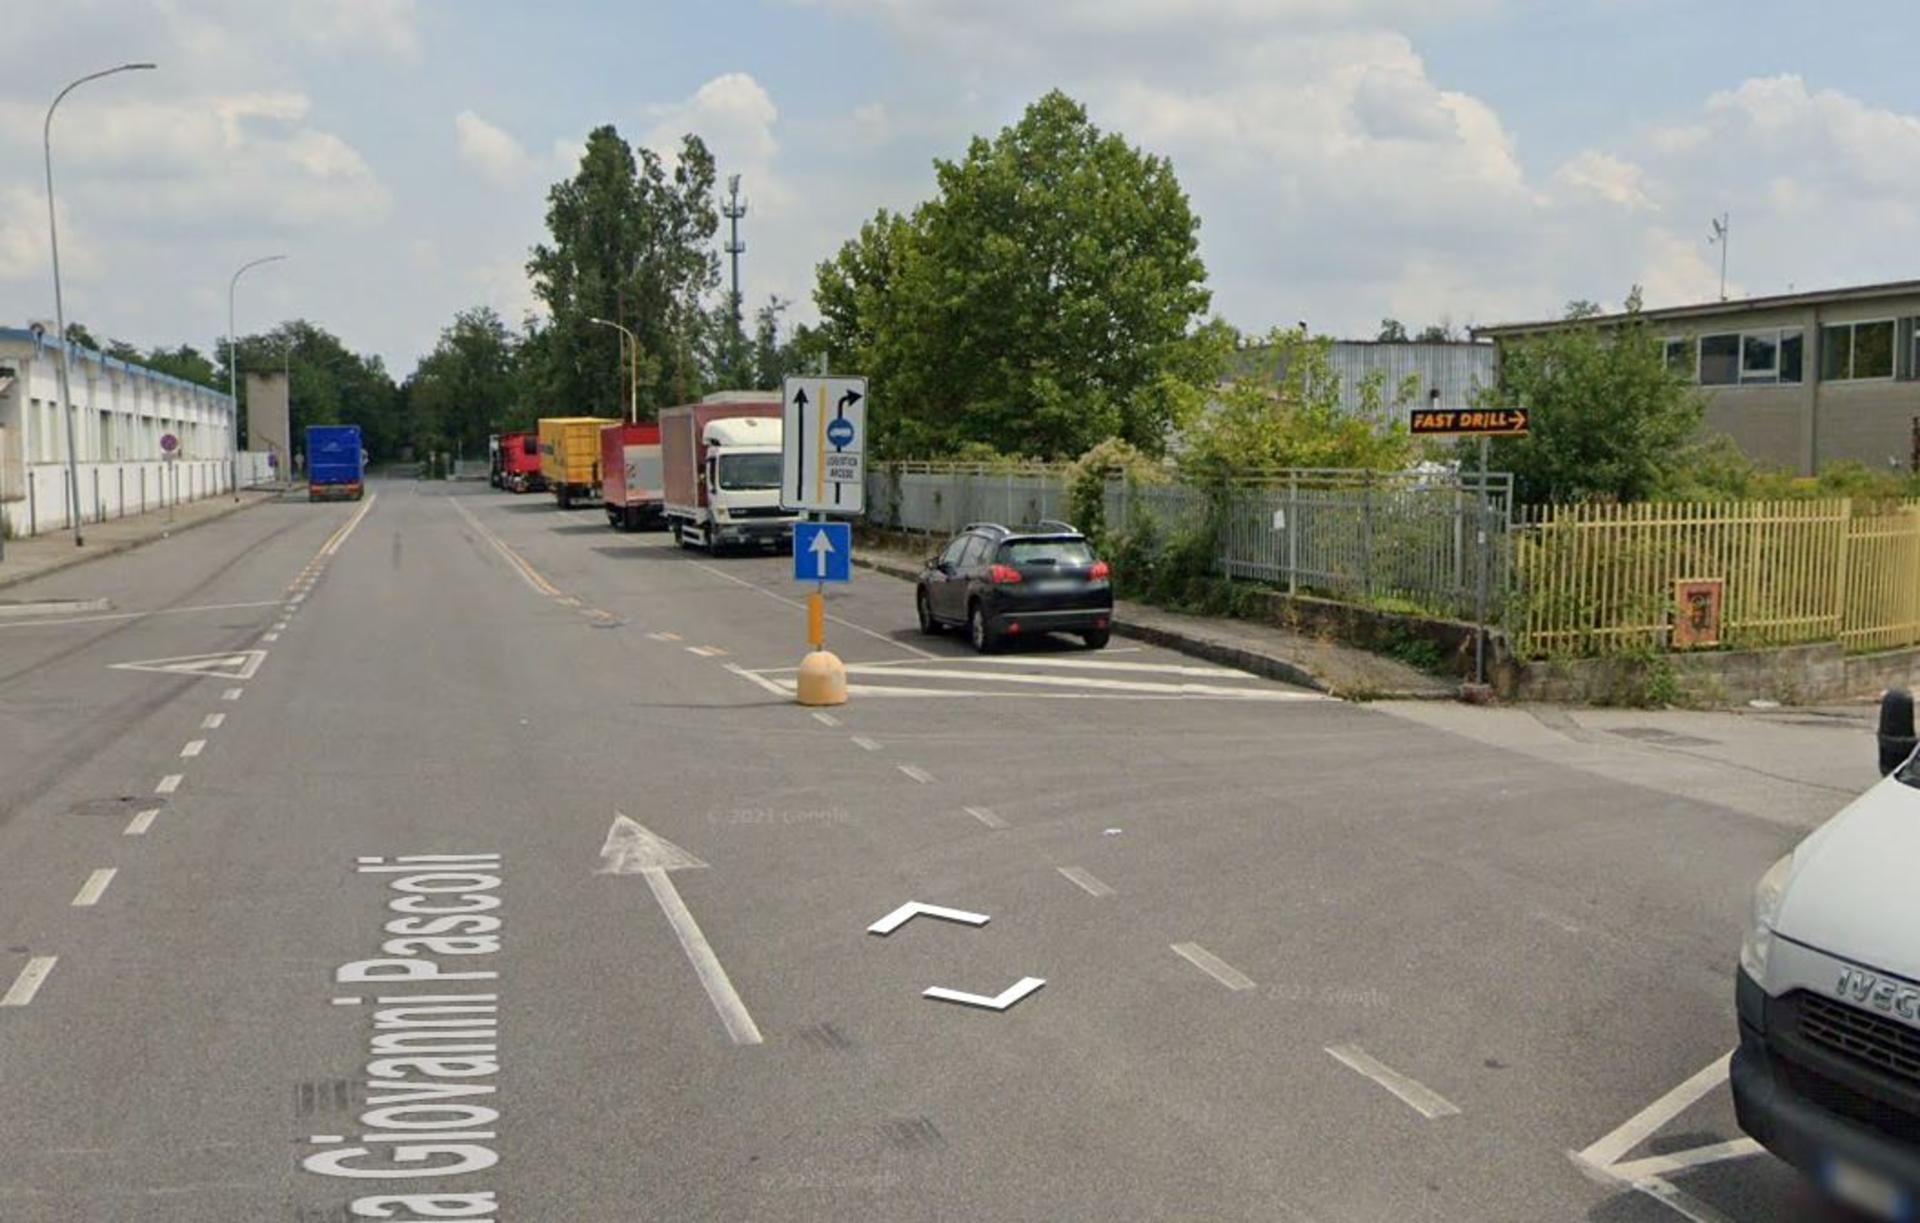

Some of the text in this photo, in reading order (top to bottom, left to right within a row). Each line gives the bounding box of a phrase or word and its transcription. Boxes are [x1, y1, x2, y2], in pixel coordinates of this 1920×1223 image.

[1413, 411, 1507, 429] FAST DRILL
[1835, 964, 1920, 1020] IVEC
